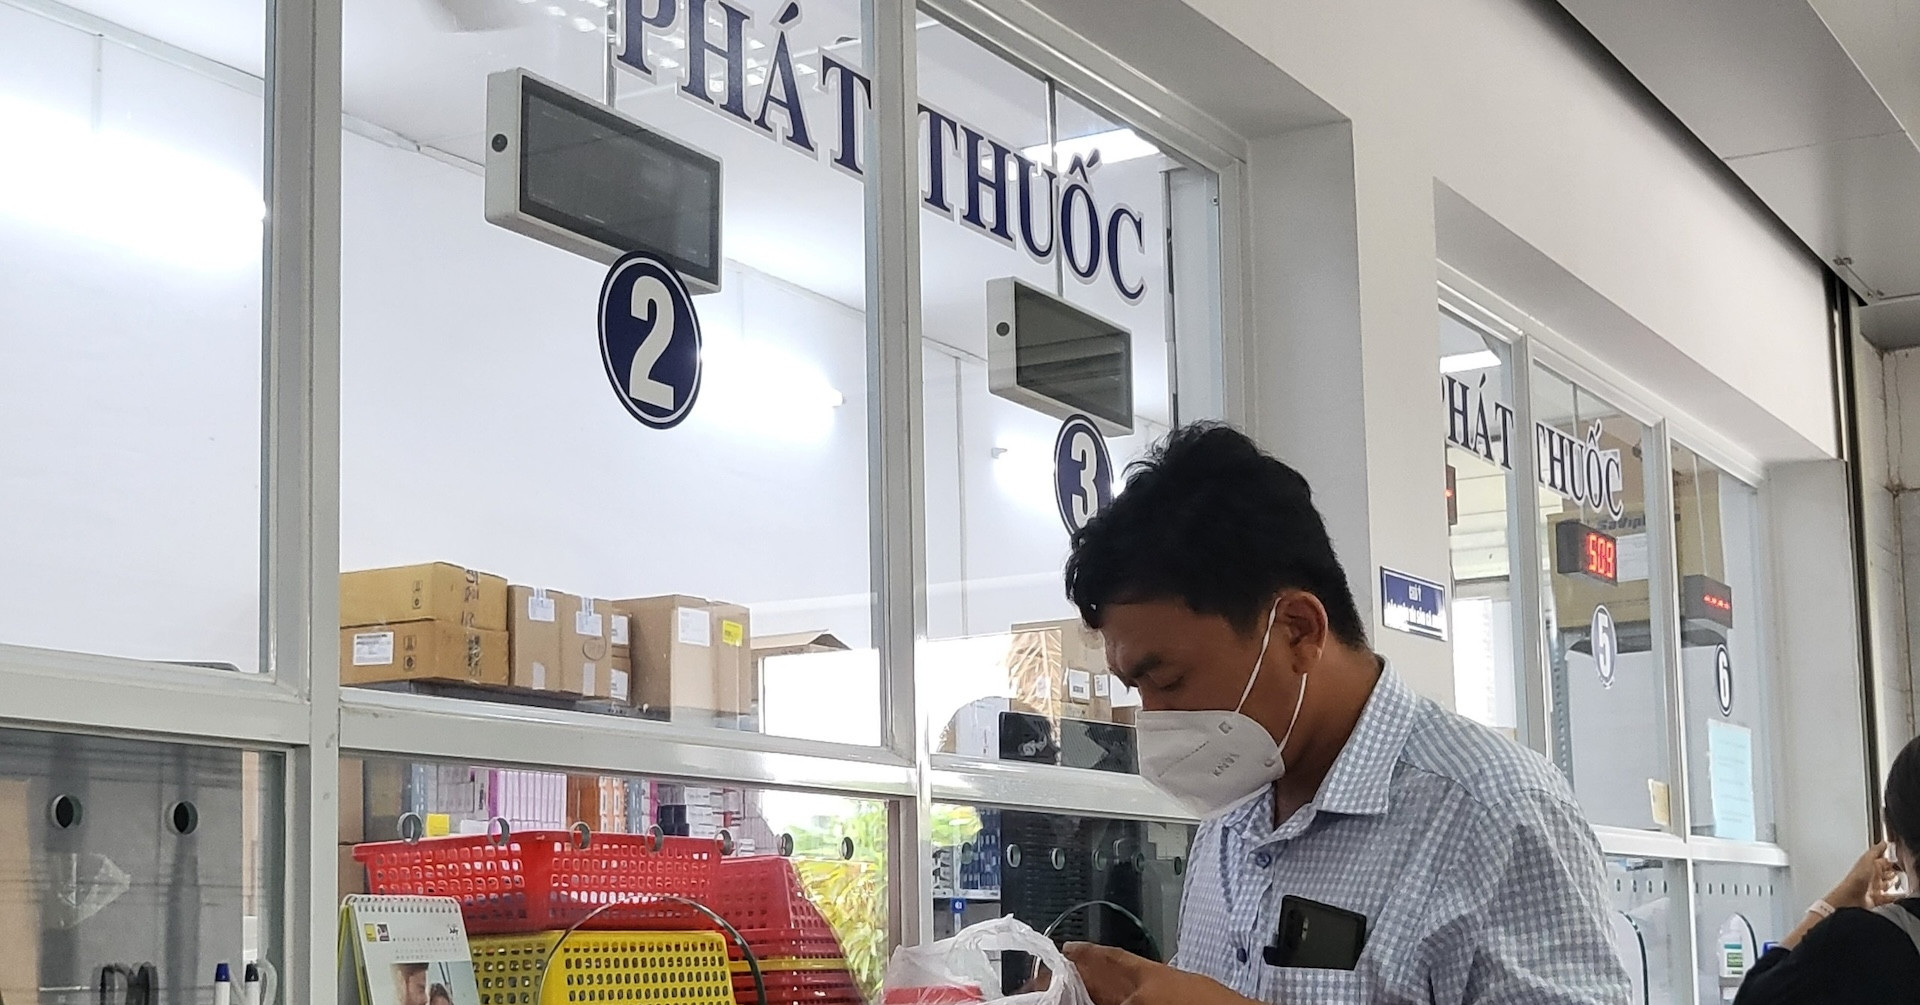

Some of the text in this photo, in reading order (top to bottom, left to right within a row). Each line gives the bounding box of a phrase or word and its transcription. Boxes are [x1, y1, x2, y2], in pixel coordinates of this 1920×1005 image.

[616, 0, 1145, 300] PHÁT THUỐC
[629, 275, 675, 411] 2
[1441, 373, 1514, 470] HÁT
[1071, 432, 1099, 529] 3
[1588, 532, 1615, 578] 509
[1598, 611, 1612, 677] 5
[1719, 650, 1731, 708] 6
